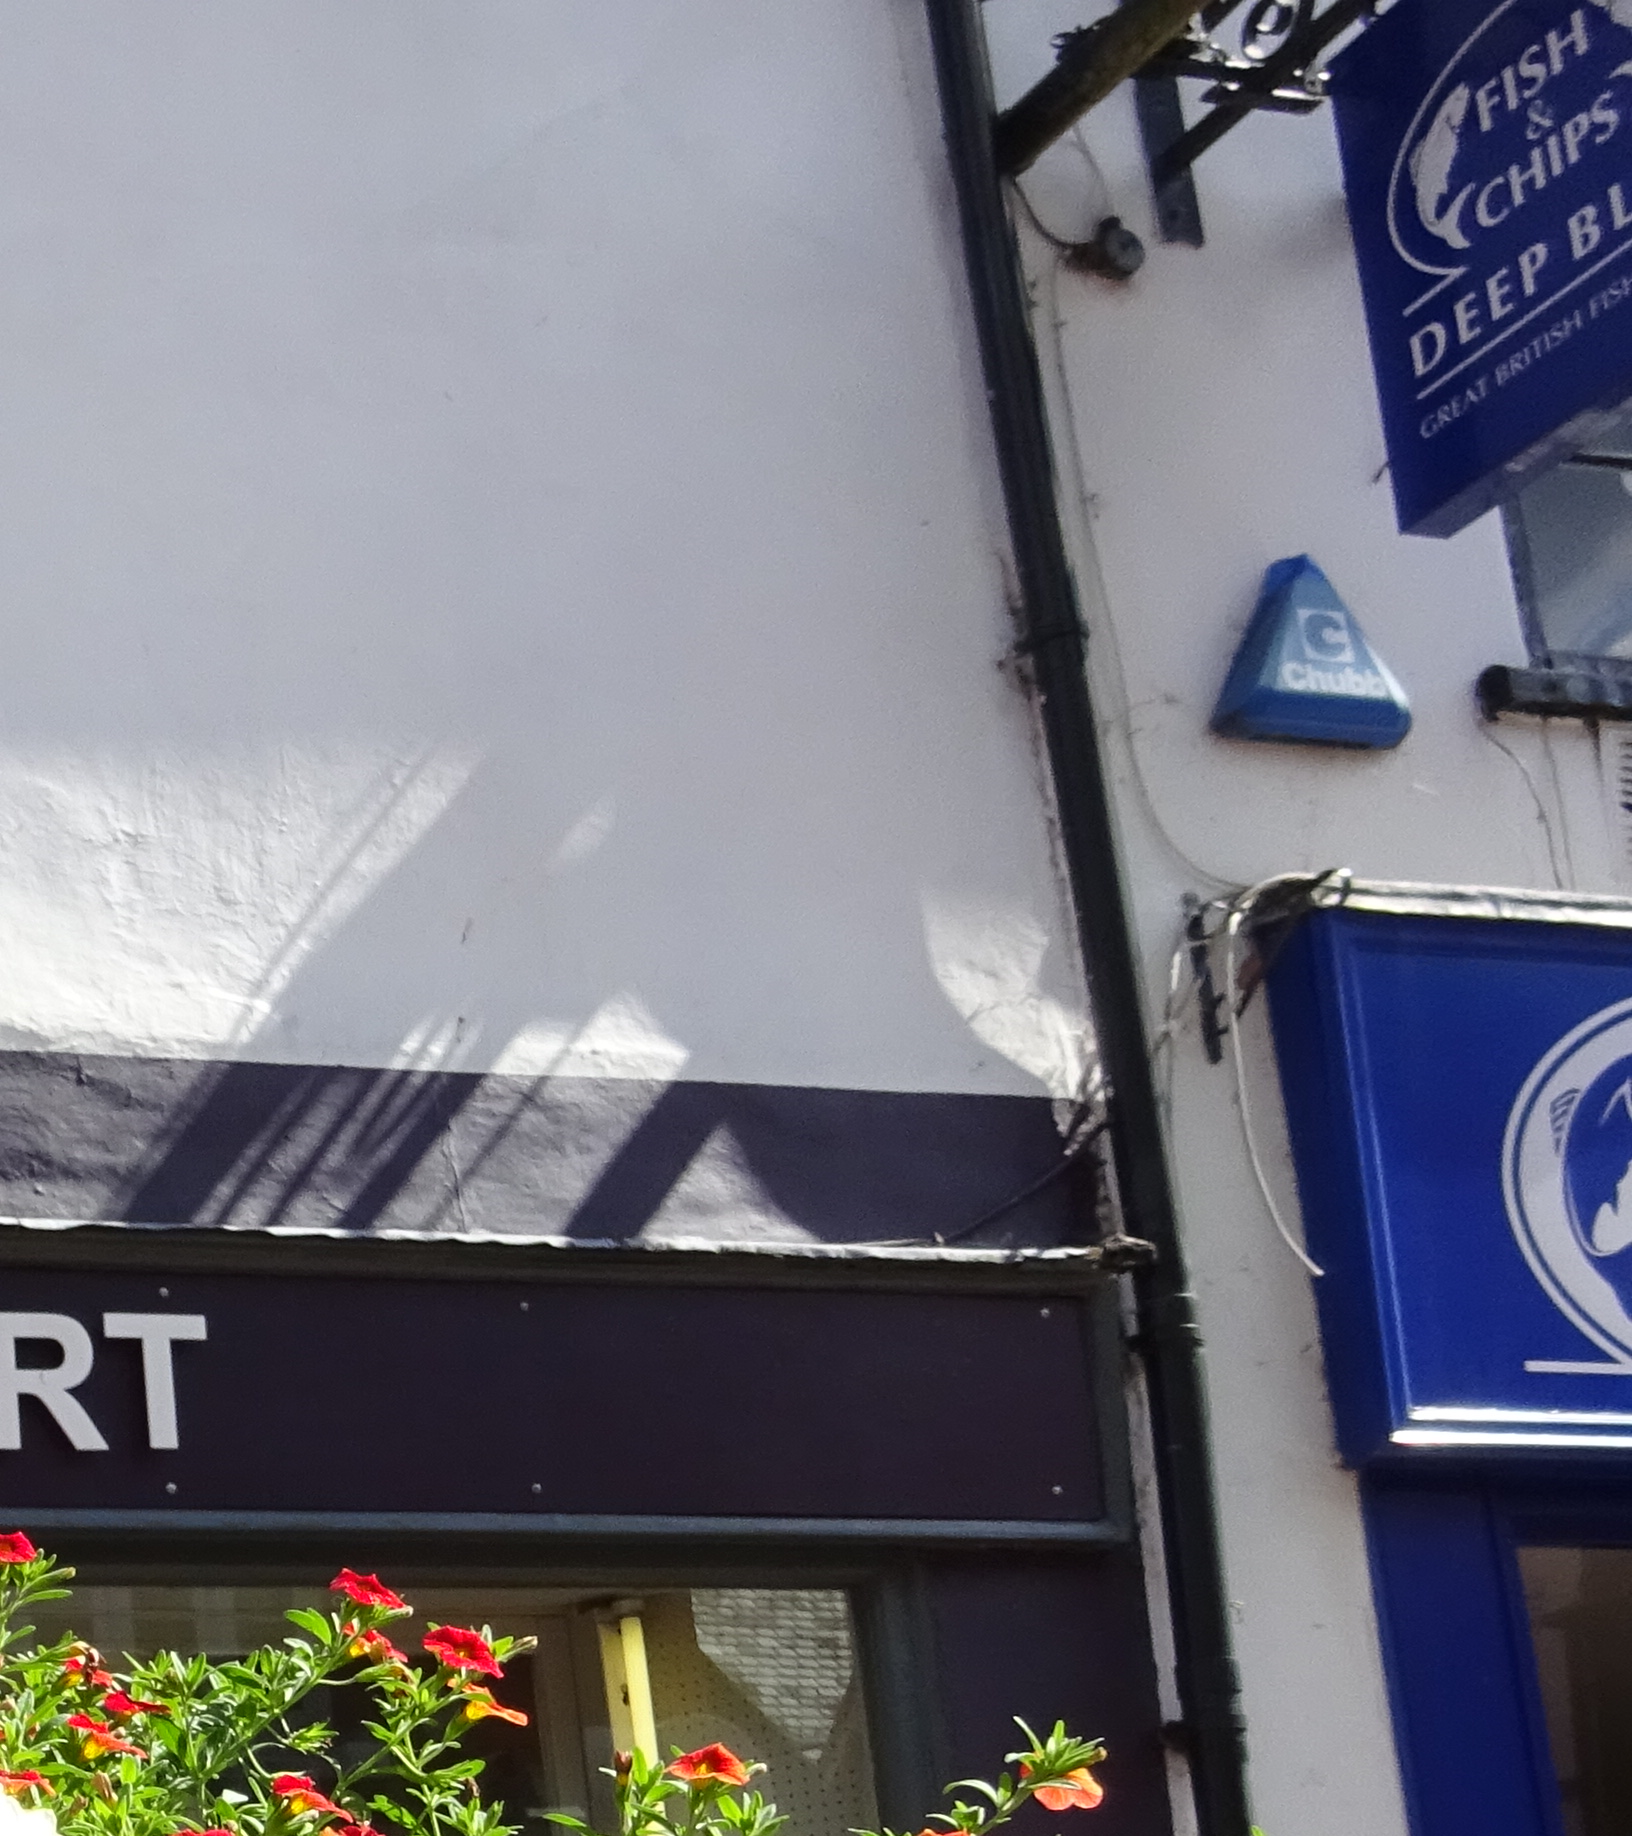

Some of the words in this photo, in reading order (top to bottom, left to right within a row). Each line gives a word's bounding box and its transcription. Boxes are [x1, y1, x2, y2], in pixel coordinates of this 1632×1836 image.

[1474, 9, 1588, 132] FISH
[1526, 99, 1554, 140] &
[1475, 88, 1620, 227] CHIPS
[1409, 242, 1549, 378] DEEP
[1567, 182, 1632, 261] BL
[1420, 376, 1488, 438] GREAT
[1495, 309, 1583, 387] BRITISH
